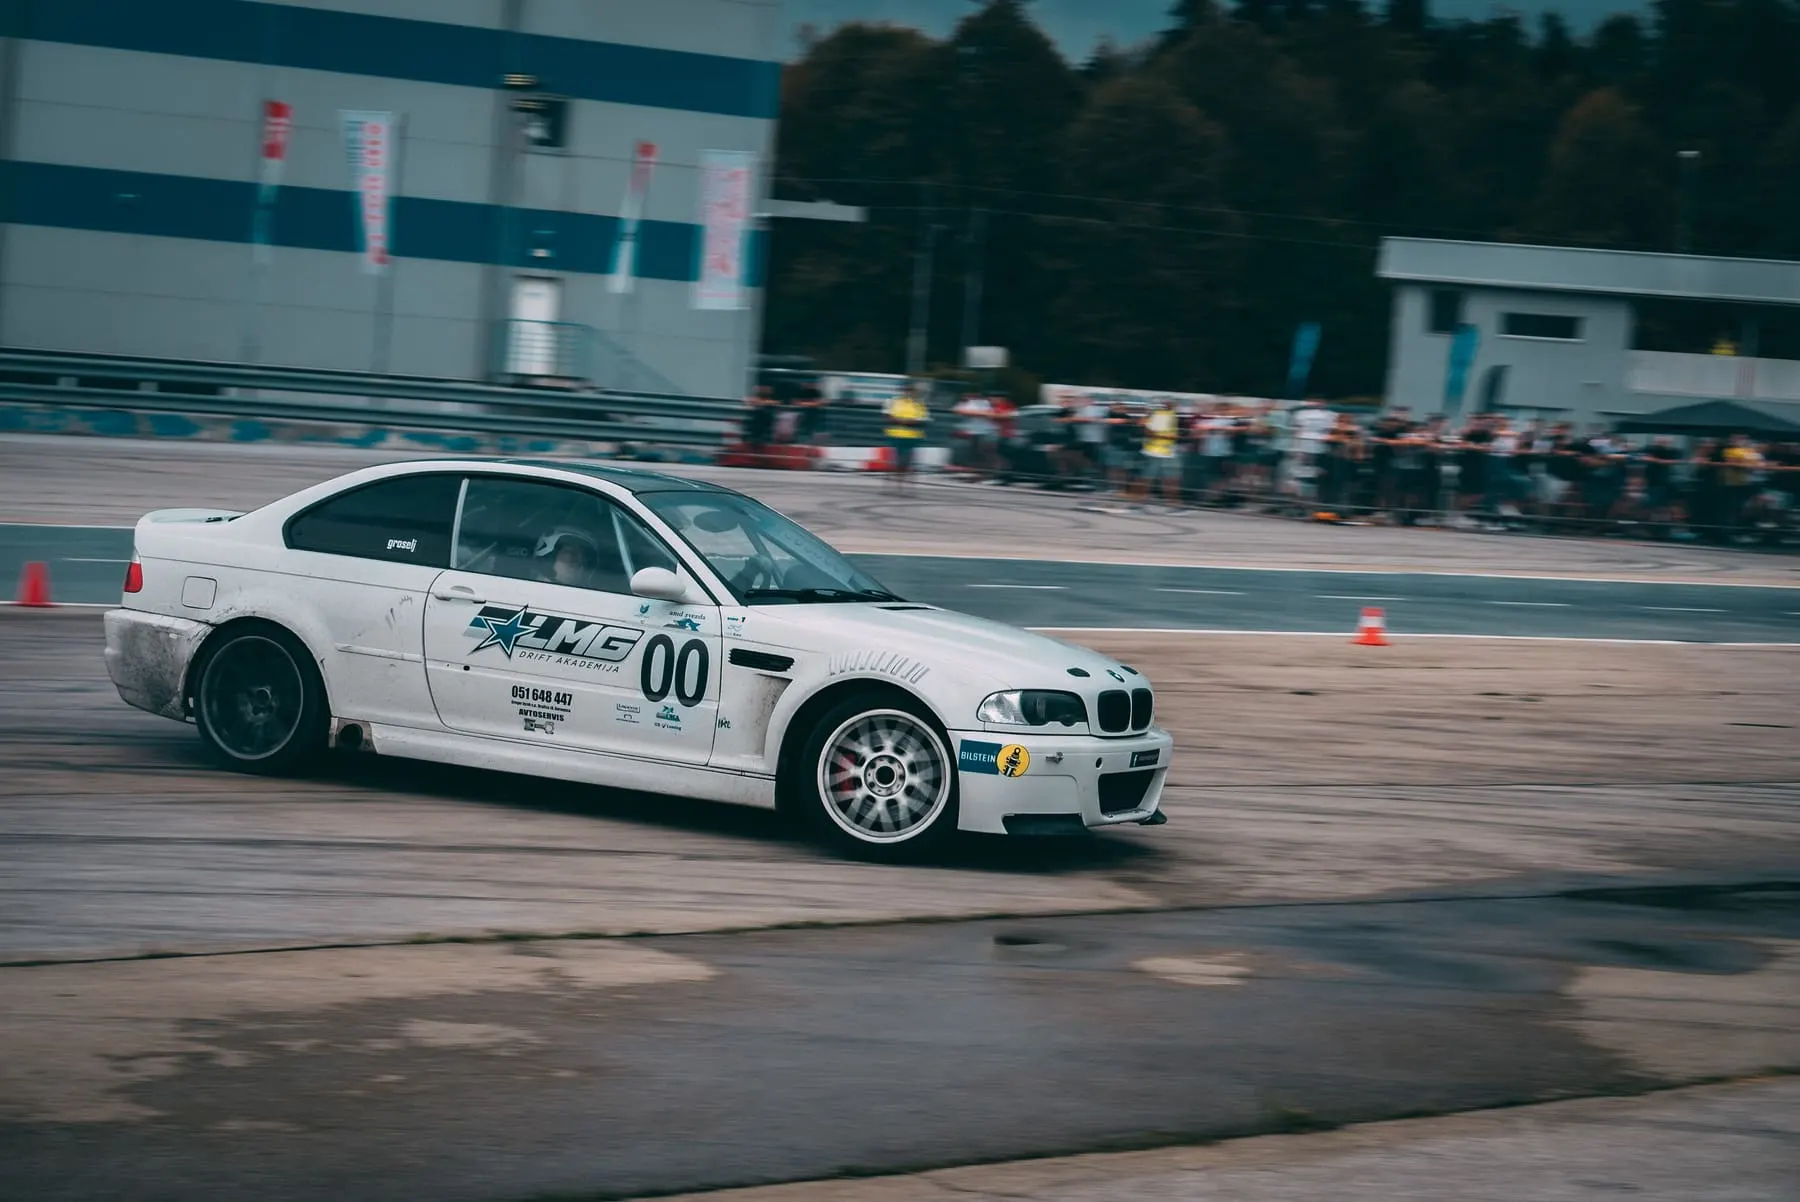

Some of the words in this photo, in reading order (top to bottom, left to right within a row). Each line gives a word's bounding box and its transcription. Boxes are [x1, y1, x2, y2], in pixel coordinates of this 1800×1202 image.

[387, 538, 417, 553] groselj
[519, 651, 552, 662] DRIFT
[555, 655, 620, 673] AKADEMIJA
[641, 633, 709, 707] 00
[511, 685, 530, 700] 051
[532, 688, 552, 703] 648
[554, 692, 573, 706] 447
[519, 708, 565, 721] AVTOSERVIS
[961, 751, 996, 763] BILSTEIN
